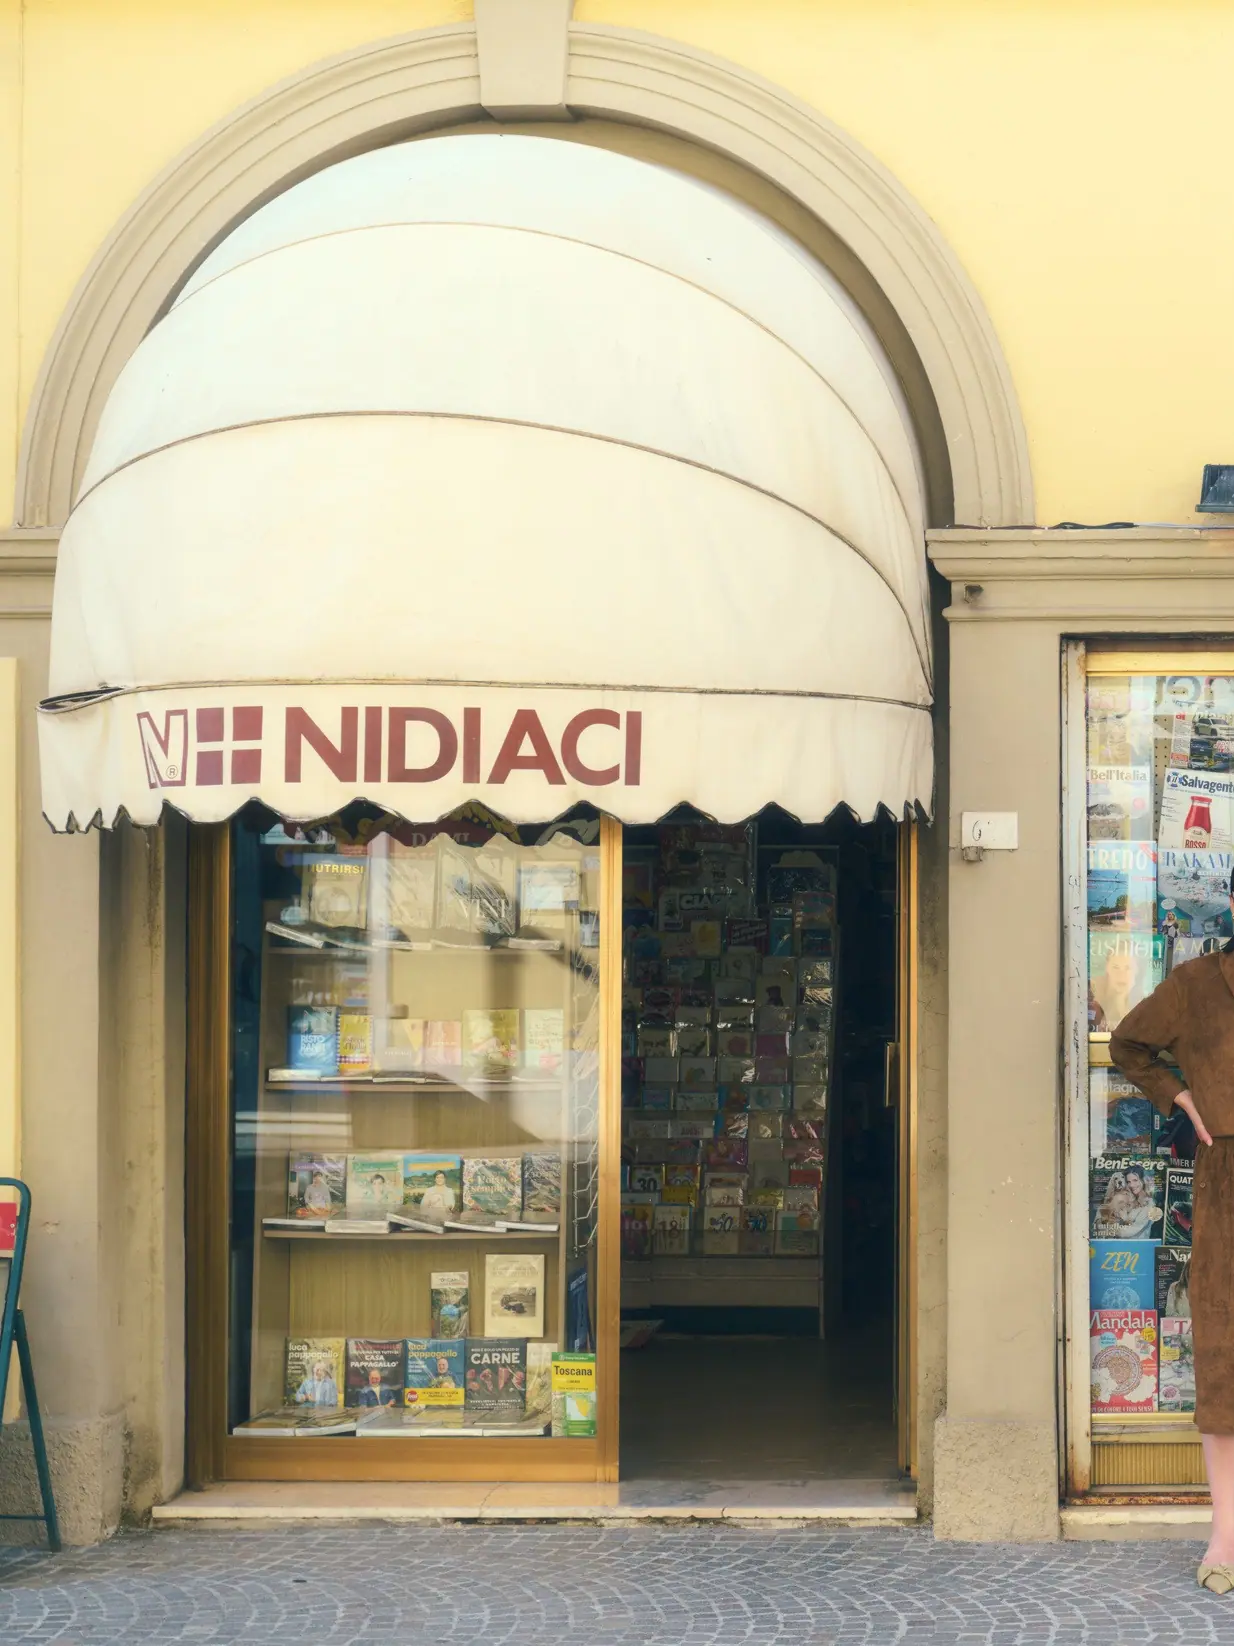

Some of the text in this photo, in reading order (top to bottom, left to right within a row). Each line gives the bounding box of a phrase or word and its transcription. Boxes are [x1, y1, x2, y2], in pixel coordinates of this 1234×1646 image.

[284, 706, 641, 786] NIDIACI
[1090, 769, 1147, 781] Bell'Italia
[1095, 1156, 1165, 1171] BenEssere
[1100, 1252, 1139, 1273] ZEN
[1089, 1312, 1155, 1329] Mandala
[470, 1353, 520, 1365] CARNE
[554, 1365, 593, 1376] Toscana
